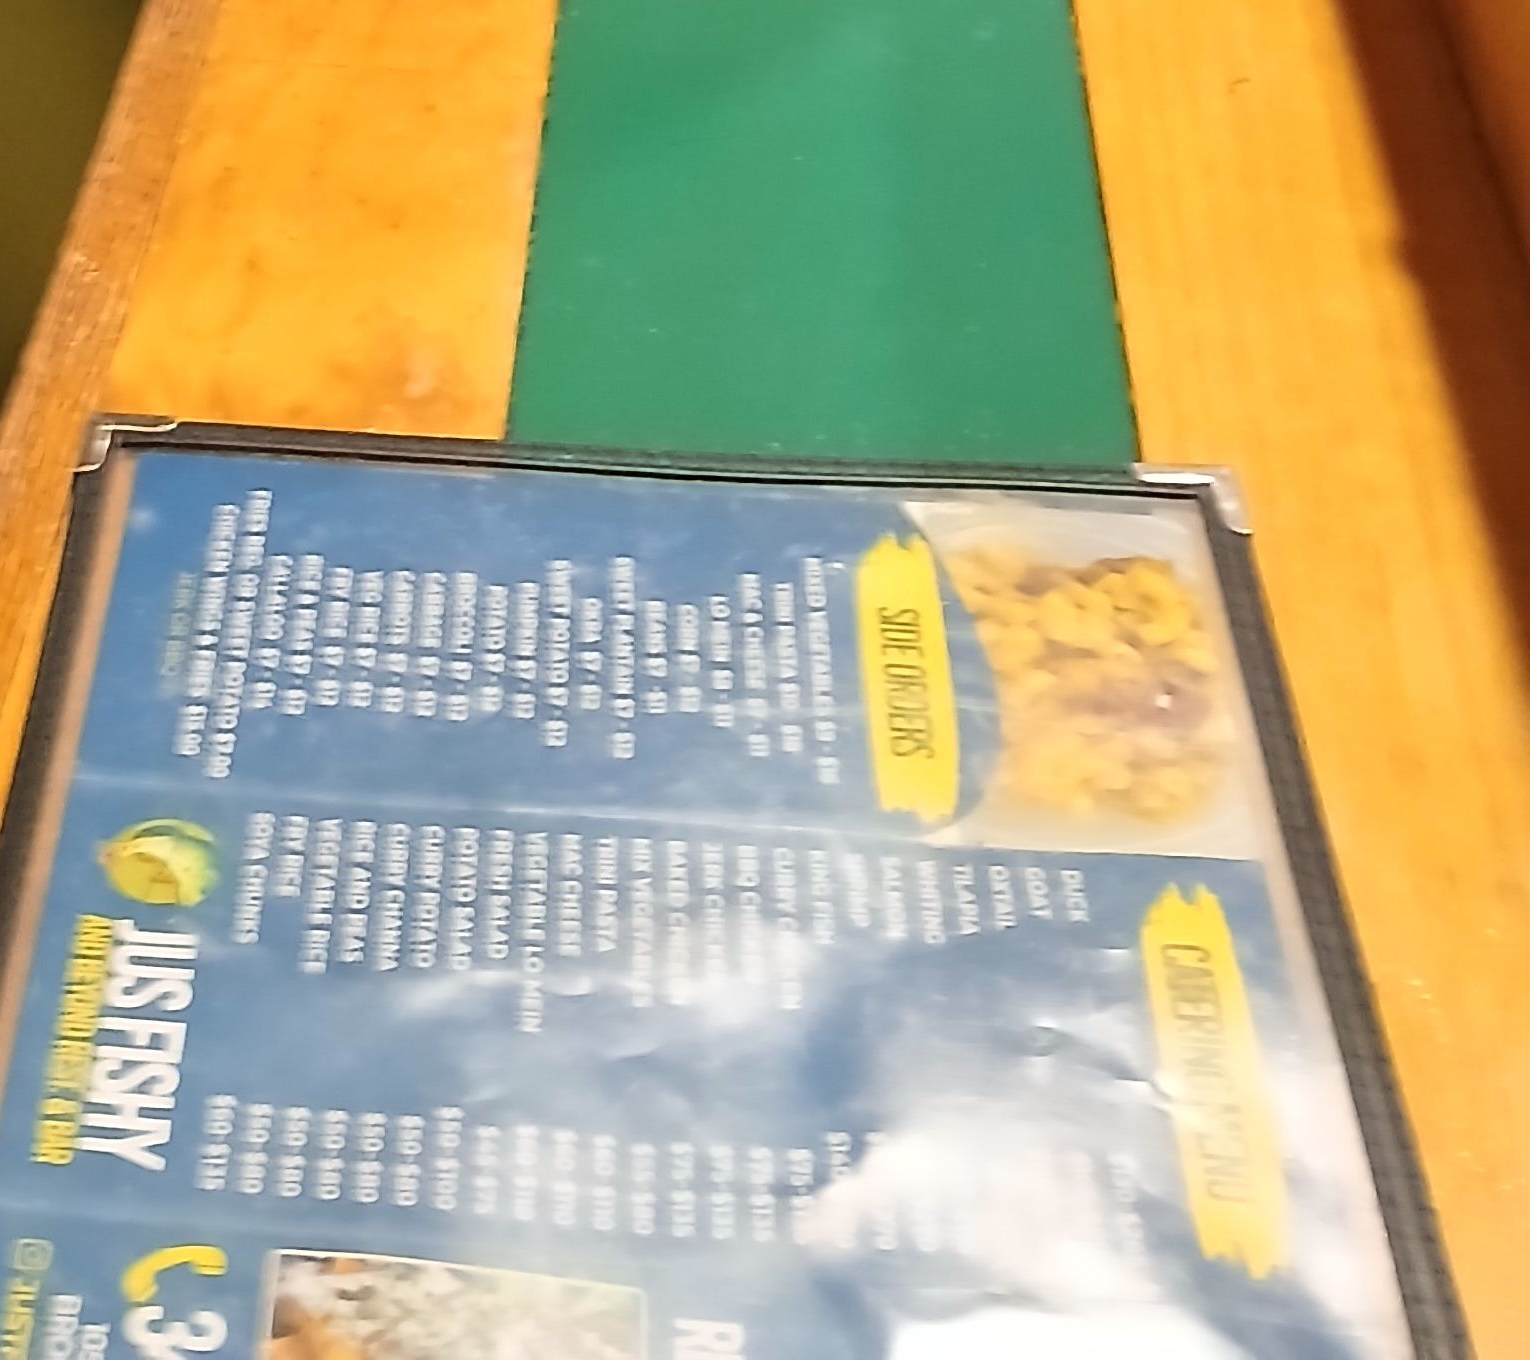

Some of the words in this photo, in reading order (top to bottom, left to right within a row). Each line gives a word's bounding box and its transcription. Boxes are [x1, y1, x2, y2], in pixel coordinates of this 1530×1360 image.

[245, 490, 273, 532] FRIES
[205, 505, 240, 572] CHICKEN
[234, 574, 260, 597] OR
[261, 556, 293, 640] CALLALOO
[297, 555, 325, 590] RICE
[328, 567, 353, 597] FRY
[358, 571, 384, 602] VEG
[545, 560, 572, 614] SWEET
[612, 557, 635, 610] SWEET
[739, 574, 762, 609] MAC
[802, 557, 826, 607] MIXED
[170, 613, 192, 636] OR
[200, 577, 228, 630] WINGS
[225, 601, 256, 659] SWEET
[289, 609, 317, 650] PEAS
[323, 601, 349, 638] RICE
[353, 606, 380, 643] RICE
[386, 571, 416, 645] CARROTS
[417, 572, 446, 648] CABBAGE
[449, 572, 478, 653] BROCCOLI
[481, 585, 508, 649] POTATO
[513, 583, 540, 656] PUMPKIN
[576, 598, 602, 643] OKRA
[644, 601, 666, 653] BEANS
[675, 605, 699, 651] CORN
[709, 596, 730, 617] LO
[544, 618, 570, 683] POTATO
[610, 615, 635, 694] PLANTAIN
[709, 621, 732, 661] MEIN
[743, 626, 766, 689] CHEESE
[776, 626, 798, 679] PASTA
[876, 607, 924, 659] SIDE
[187, 650, 217, 696] FRIES
[215, 662, 247, 729] POTATO
[882, 663, 935, 760] ORDERS
[205, 733, 238, 777] $7.00
[242, 812, 276, 860] SOYA
[279, 816, 310, 851] FRY
[348, 822, 378, 862] RICE
[380, 824, 411, 886] CURRY
[414, 826, 446, 888] CURRY
[485, 830, 514, 890] FRESH
[559, 834, 582, 875] MAC
[631, 838, 653, 872] MIX
[273, 854, 305, 897] RICE
[304, 819, 343, 924] VEGETABLE
[449, 828, 480, 902] POTATO
[522, 832, 549, 940] VEGETABLE
[596, 837, 618, 884] TRINI
[666, 841, 688, 908] BAKED
[702, 842, 725, 890] JERK
[736, 846, 760, 886] BBQ
[773, 848, 798, 913] CURRY
[807, 850, 831, 894] KING
[231, 865, 268, 944] CHUNKS
[341, 867, 372, 909] AND
[880, 856, 908, 940] SALMON
[918, 860, 945, 944] WHITING
[953, 865, 980, 935] TILAPIA
[987, 866, 1017, 929] OXTAIL
[1025, 867, 1053, 919] GOAT
[1060, 870, 1089, 922] DUCK
[76, 914, 112, 955] AND
[336, 914, 368, 962] PEAS
[373, 890, 405, 971] CHANNA
[409, 892, 440, 968] POTATO
[449, 907, 475, 970] SALAD
[484, 895, 511, 959] SALAD
[556, 880, 582, 957] CHEESE
[595, 890, 618, 952] PASTA
[631, 878, 654, 1007] VEGETABLES
[810, 902, 836, 944] FISH
[103, 919, 200, 1011] JUS
[299, 930, 330, 974] RICE
[522, 947, 545, 971] LO
[59, 958, 107, 1038] BEYOND
[516, 981, 543, 1032] MEIN
[1161, 943, 1237, 1093] CATERING
[71, 1017, 188, 1171] FISHY
[30, 1120, 77, 1165] BAR
[1193, 1103, 1258, 1204] MENU
[120, 1306, 228, 1360] 3
